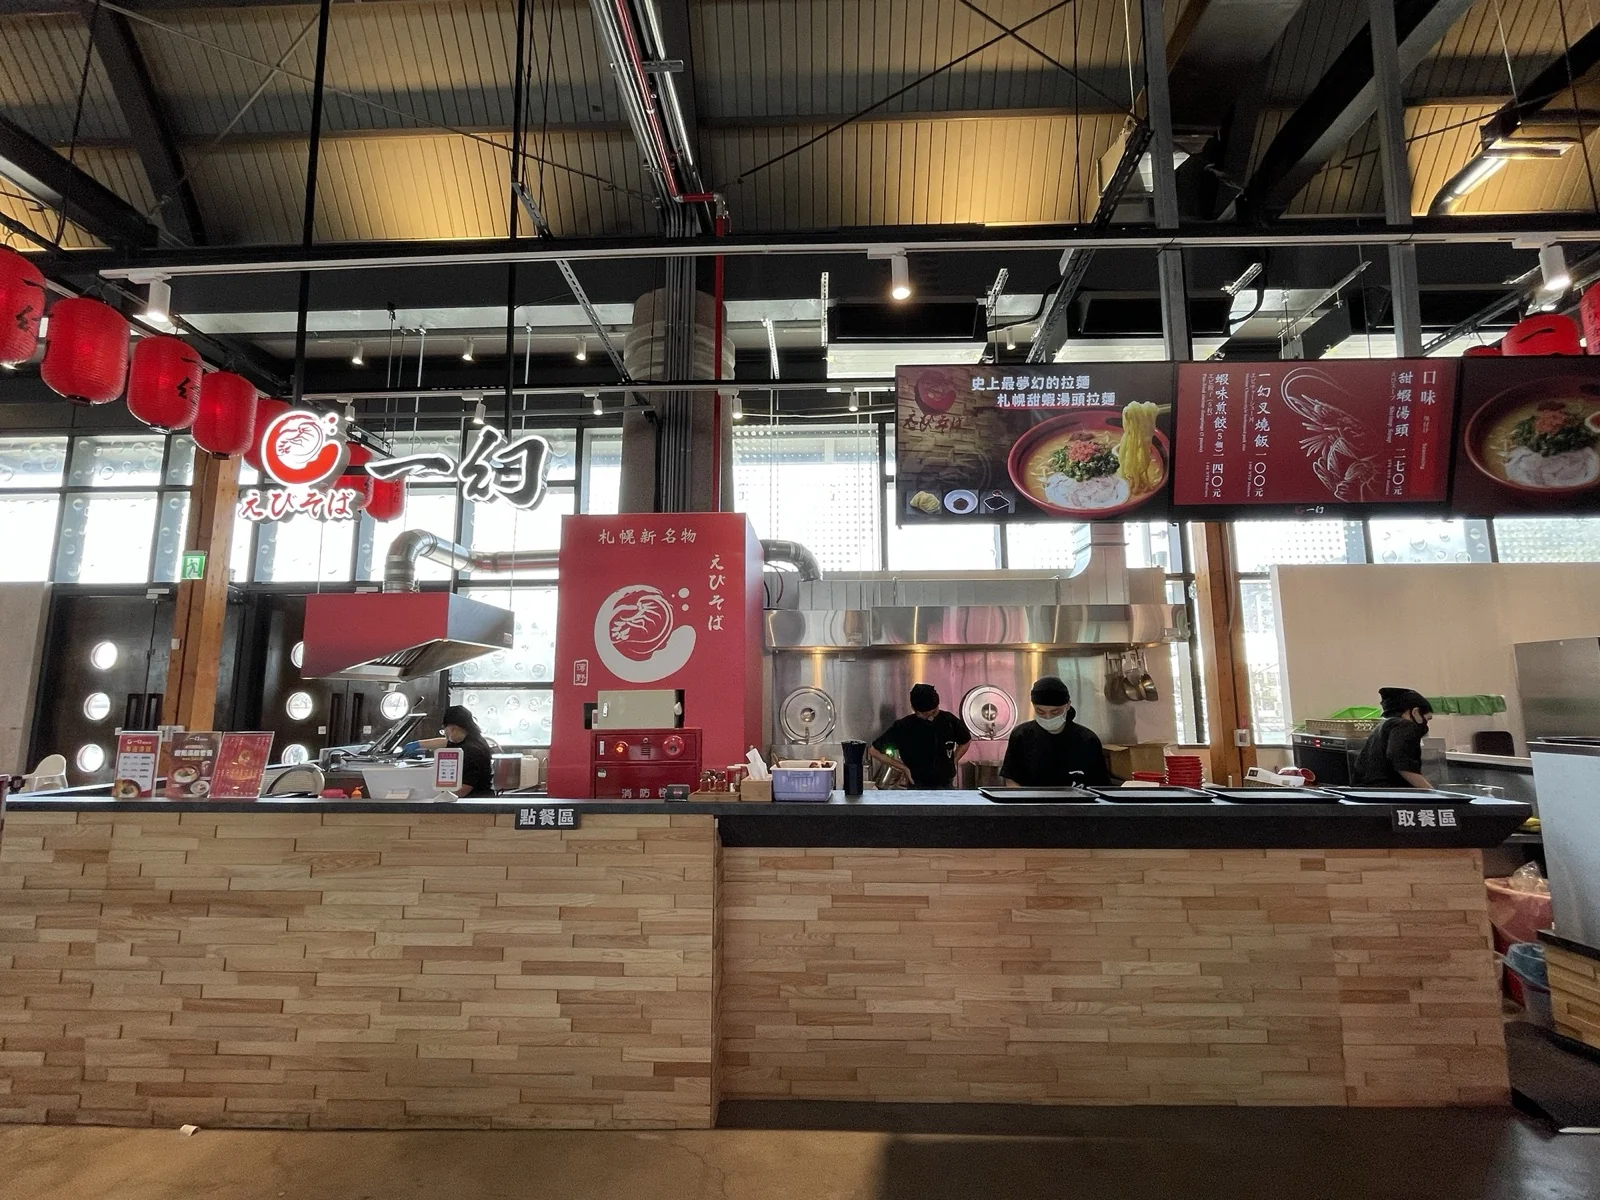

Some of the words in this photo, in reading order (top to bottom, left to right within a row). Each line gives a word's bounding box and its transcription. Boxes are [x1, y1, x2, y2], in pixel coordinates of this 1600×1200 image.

[972, 375, 1090, 391] 史上最夢幻的拉麵
[1421, 371, 1436, 405] 口味
[997, 391, 1116, 408] 札幌甜蝦湯頭拉麵
[1254, 373, 1271, 448] 一幻叉燒飯
[1394, 371, 1413, 437] 甜蝦湯頭
[238, 487, 358, 521] えびそば
[597, 527, 697, 545] 札幌新名物
[707, 554, 726, 632] えびそば
[519, 808, 575, 826] 點餐區
[1396, 809, 1457, 828] 取餐區
